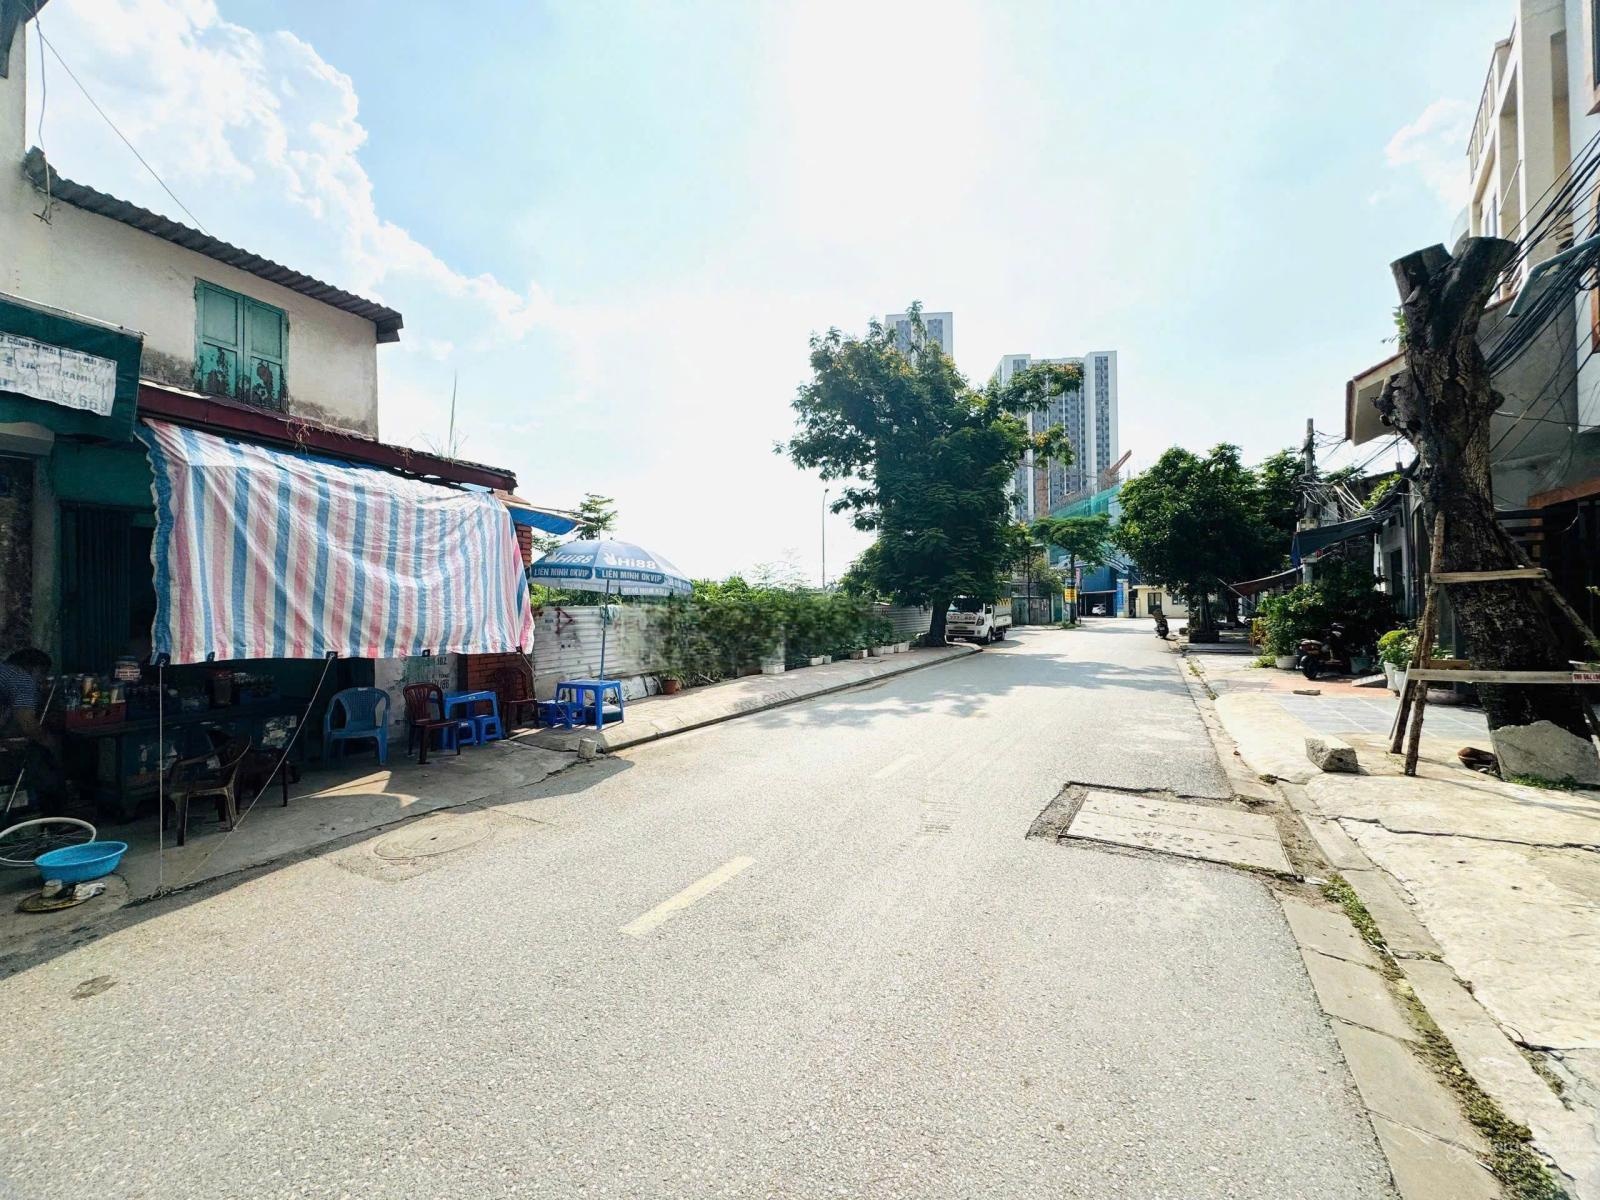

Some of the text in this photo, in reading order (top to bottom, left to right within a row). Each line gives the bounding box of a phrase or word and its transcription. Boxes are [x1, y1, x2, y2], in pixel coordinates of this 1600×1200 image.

[551, 568, 569, 577] MINH
[570, 568, 590, 577] OKVIP
[620, 571, 640, 580] MINH
[641, 573, 662, 582] OKVIP
